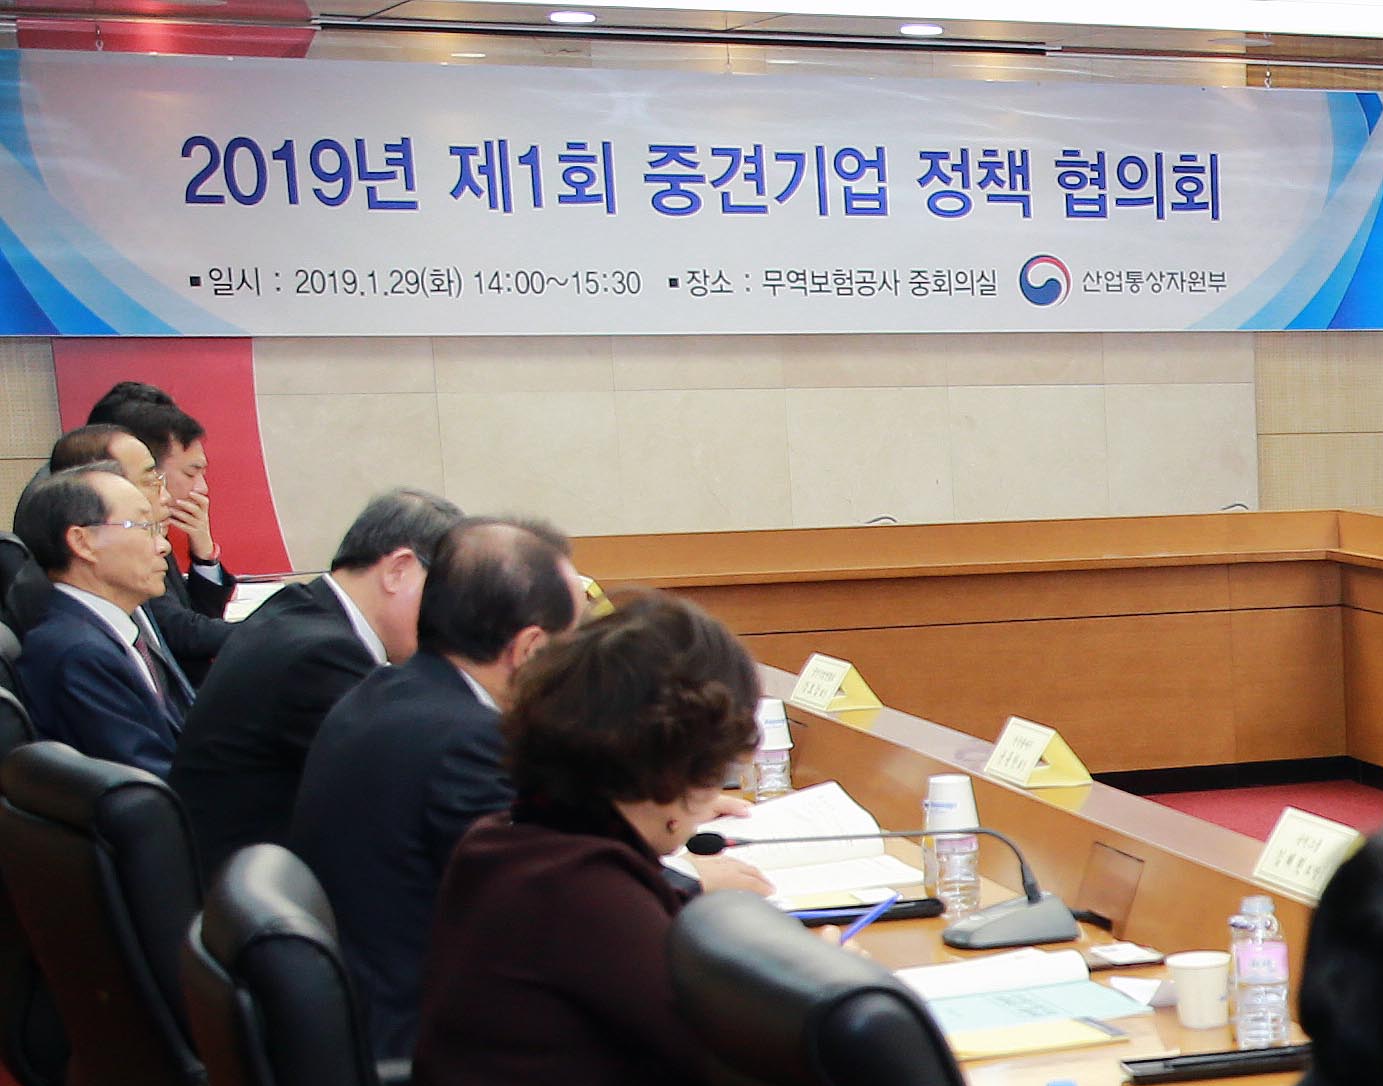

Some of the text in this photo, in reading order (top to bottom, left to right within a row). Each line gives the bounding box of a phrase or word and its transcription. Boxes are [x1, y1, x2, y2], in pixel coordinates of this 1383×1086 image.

[181, 135, 1221, 221] 2019년 제1회 중견기업 정책 협의회
[208, 266, 261, 297] 일시
[295, 268, 464, 298] 2019.1.29(화)
[686, 269, 734, 296] 장소
[762, 269, 900, 297] 무역보험공사
[909, 269, 998, 296] 중회의실
[1082, 270, 1228, 293] 산업통상자원부
